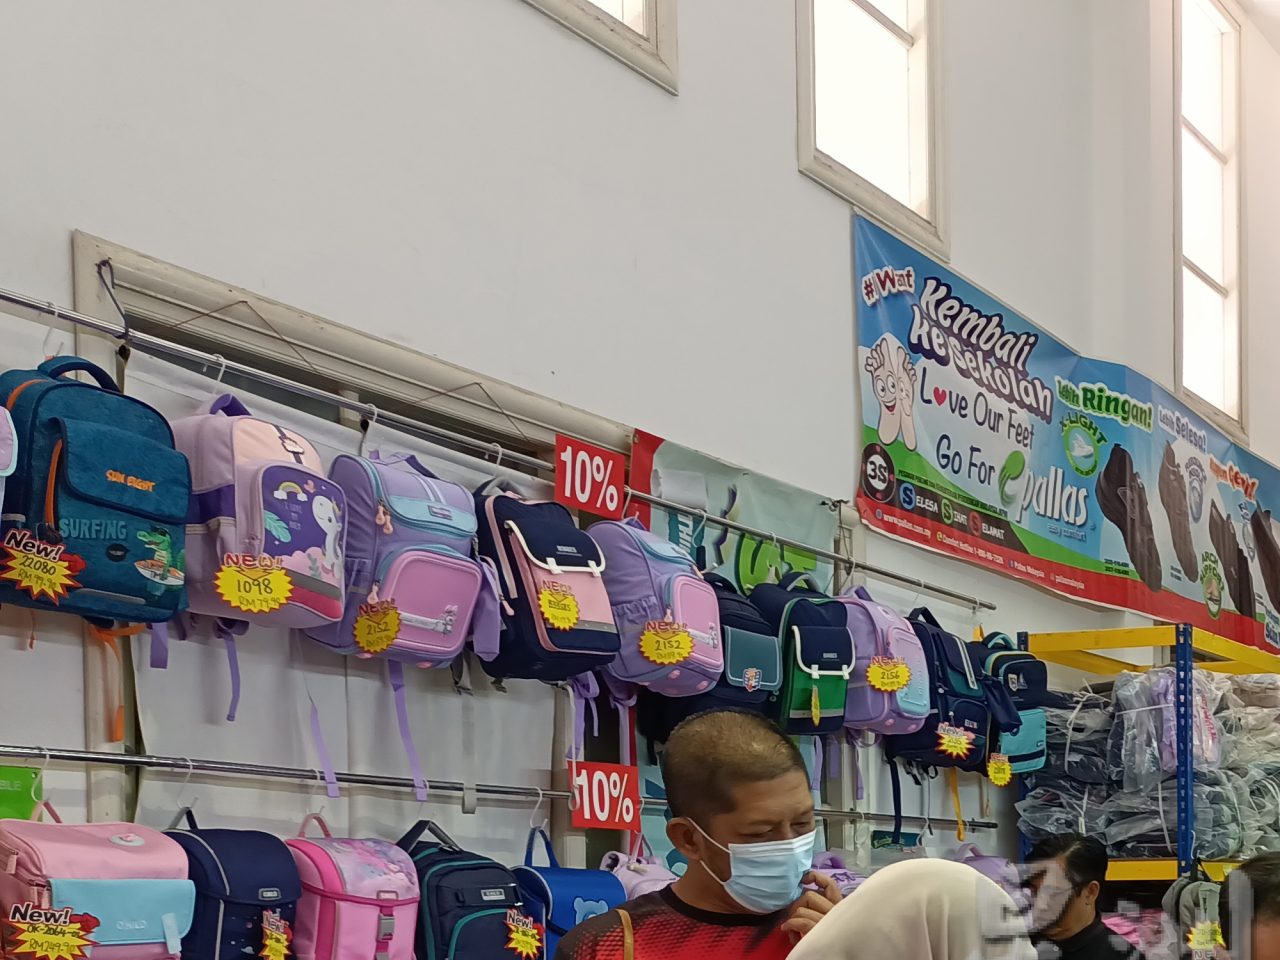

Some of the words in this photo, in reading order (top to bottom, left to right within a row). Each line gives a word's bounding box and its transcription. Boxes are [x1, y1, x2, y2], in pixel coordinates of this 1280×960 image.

[920, 279, 1037, 371] Kembali
[949, 336, 1052, 416] sekolah
[973, 392, 1003, 434] Our
[1008, 407, 1035, 449] Feet
[1082, 387, 1153, 430] Ringan!
[936, 434, 962, 475] Go
[968, 445, 996, 485] For
[560, 445, 619, 512] 10%
[1016, 465, 1090, 527] pallas
[5, 531, 64, 561] New!
[60, 518, 127, 539] SURFING
[18, 555, 56, 576] 22080
[237, 579, 273, 595] 1098
[366, 622, 390, 635] 2152
[655, 639, 682, 651] 2152
[881, 671, 900, 680] 2156
[575, 768, 634, 823] 10%
[11, 902, 70, 926] New!
